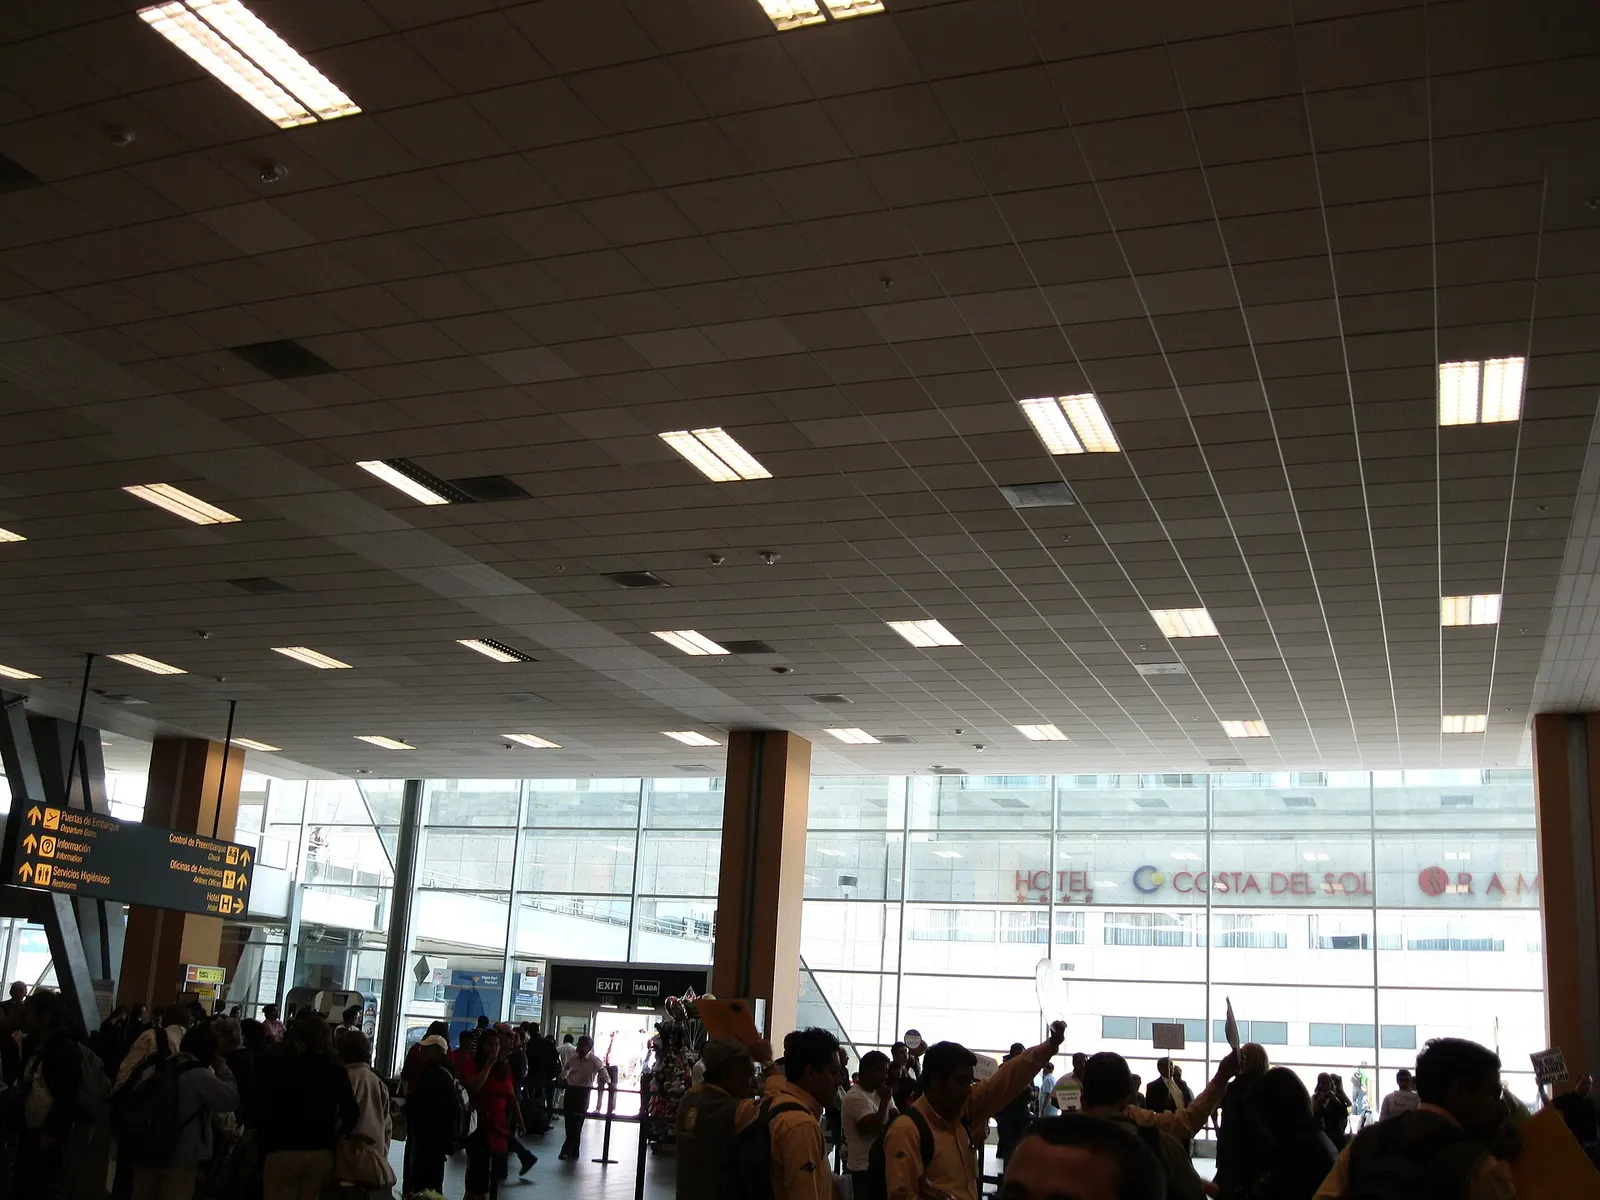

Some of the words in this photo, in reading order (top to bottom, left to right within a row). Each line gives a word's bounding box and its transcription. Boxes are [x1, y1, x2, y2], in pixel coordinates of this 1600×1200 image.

[61, 811, 83, 825] Puertas
[83, 816, 91, 826] de
[91, 818, 120, 832] Embarque
[60, 824, 83, 835] Departure
[57, 838, 91, 854] Información
[169, 833, 188, 844] Control
[188, 837, 195, 847] de
[195, 838, 226, 853] Preembarque
[56, 851, 83, 863] Information
[169, 859, 190, 872] Oficinas
[190, 863, 198, 873] de
[52, 865, 80, 880] Servicios
[80, 869, 111, 885] Higiénicos
[1015, 869, 1094, 893] HOTEL
[51, 878, 78, 890] Restrooms
[1172, 871, 1261, 894] COSTA
[1270, 872, 1316, 895] DEL
[1324, 872, 1373, 895] SOL
[206, 892, 220, 902] Hotel
[597, 981, 621, 991] EXIT
[634, 983, 658, 992] SALIDA
